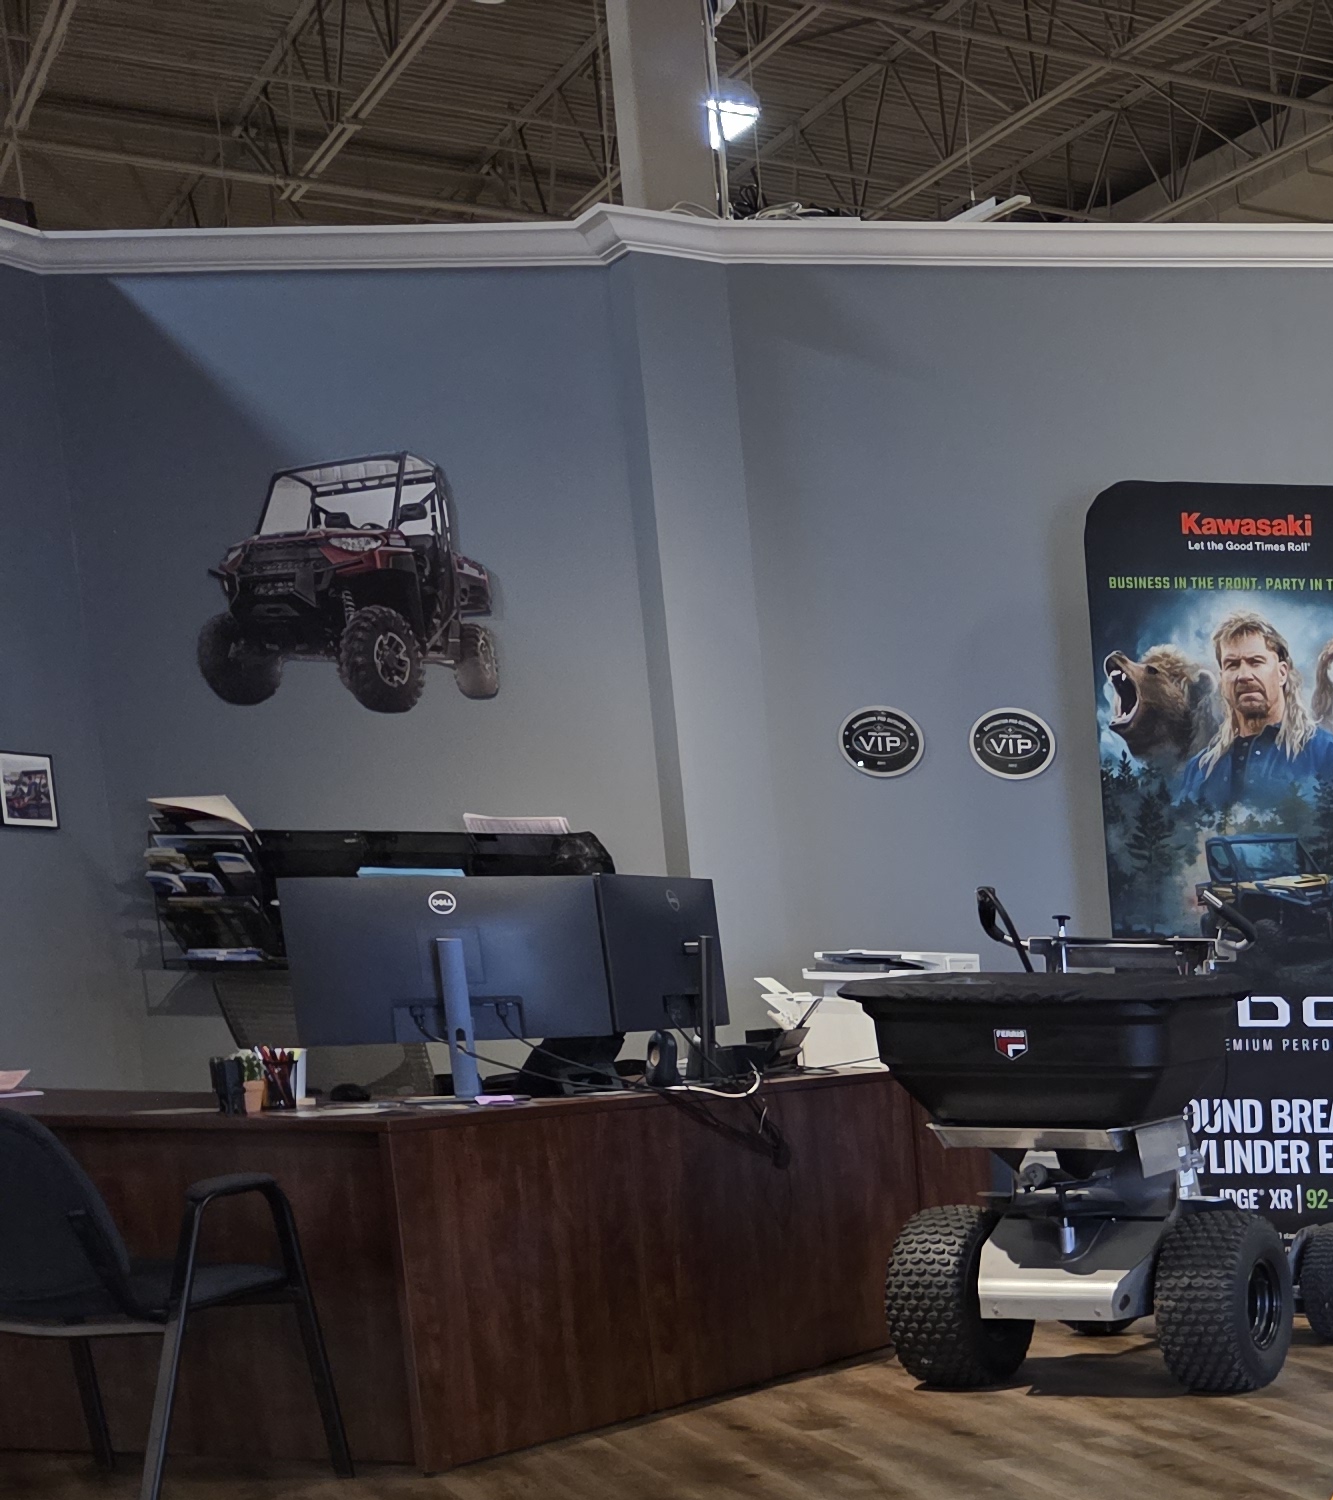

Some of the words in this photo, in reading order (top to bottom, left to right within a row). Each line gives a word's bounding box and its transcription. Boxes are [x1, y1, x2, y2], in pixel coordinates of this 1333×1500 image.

[1181, 512, 1312, 536] Kawasaki
[1188, 541, 1204, 550] Let
[1207, 541, 1224, 551] the
[1226, 541, 1253, 551] Good
[1255, 541, 1285, 551] Times
[1288, 542, 1308, 552] Roll
[1109, 577, 1170, 589] BUSINESS
[1174, 577, 1187, 589] IN
[1190, 577, 1214, 589] THE
[1218, 577, 1262, 590] FRONT.
[1265, 578, 1306, 590] PARTY
[1310, 579, 1323, 590] IN
[859, 736, 901, 752] VIP
[989, 738, 1033, 755] VIP
[432, 898, 453, 906] DELL
[1269, 1189, 1293, 1209] XR
